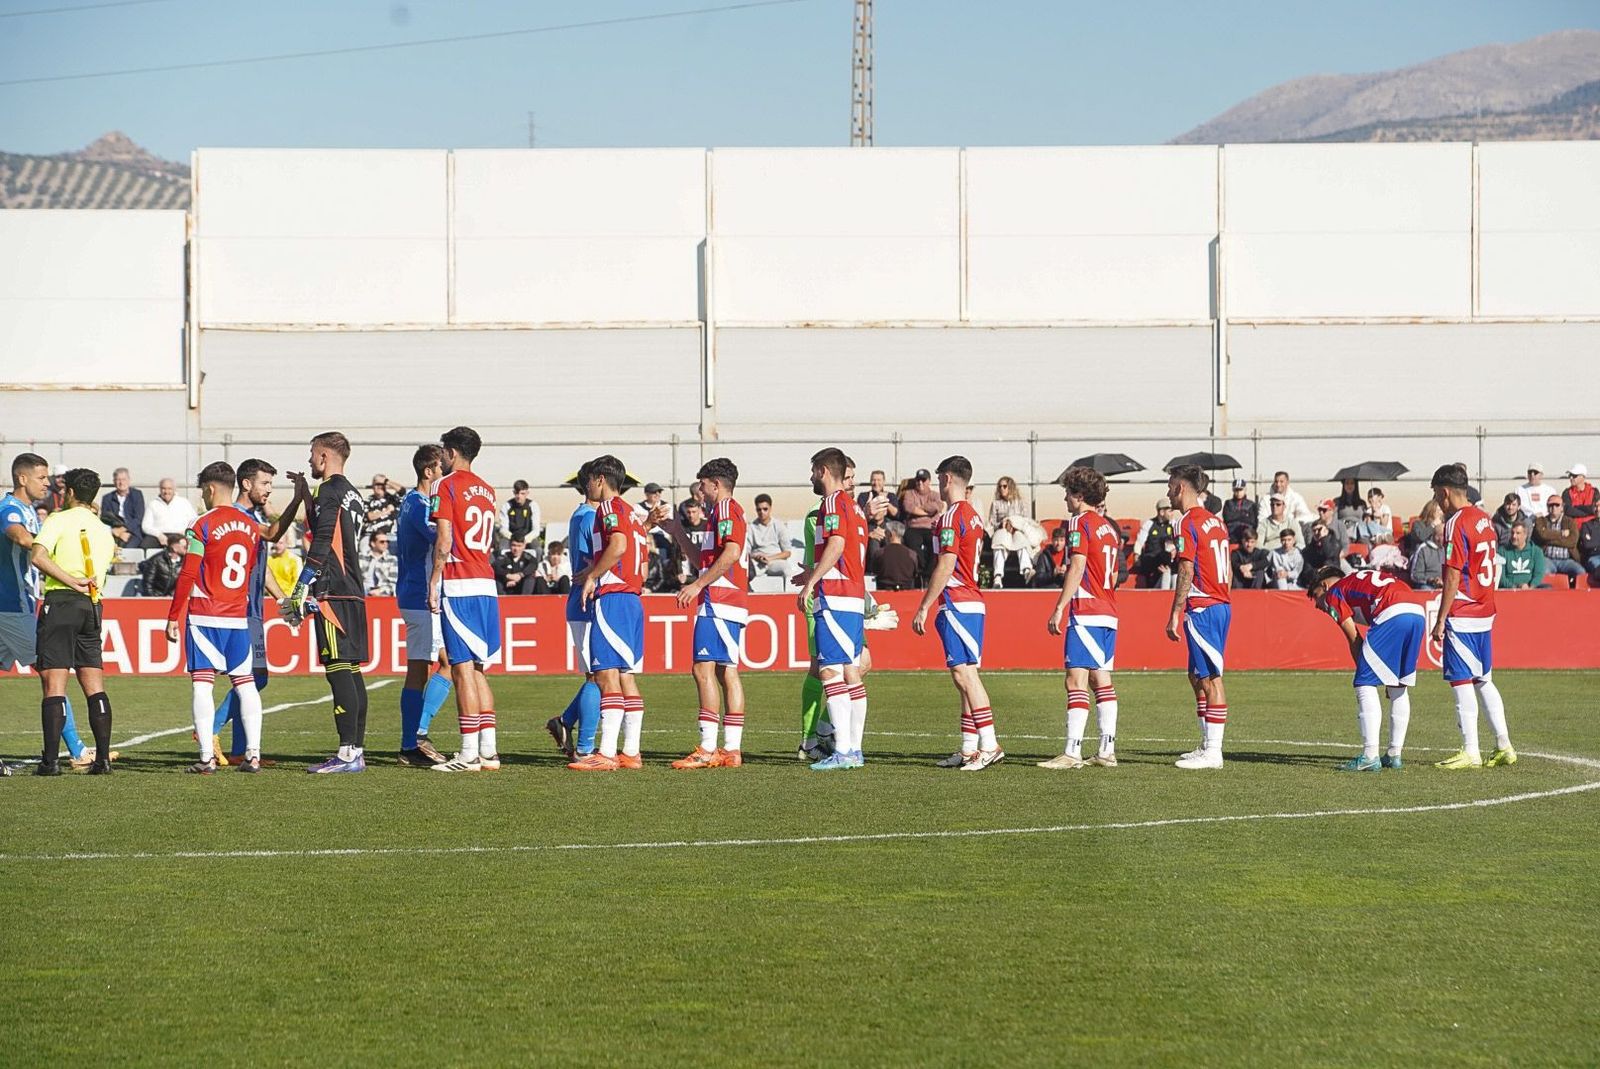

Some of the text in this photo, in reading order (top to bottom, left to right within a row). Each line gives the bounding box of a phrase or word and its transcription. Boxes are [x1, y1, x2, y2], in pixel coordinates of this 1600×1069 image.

[212, 520, 251, 540] JUANMA
[464, 505, 495, 554] 20
[222, 544, 248, 589] 8
[1210, 539, 1230, 584] 10
